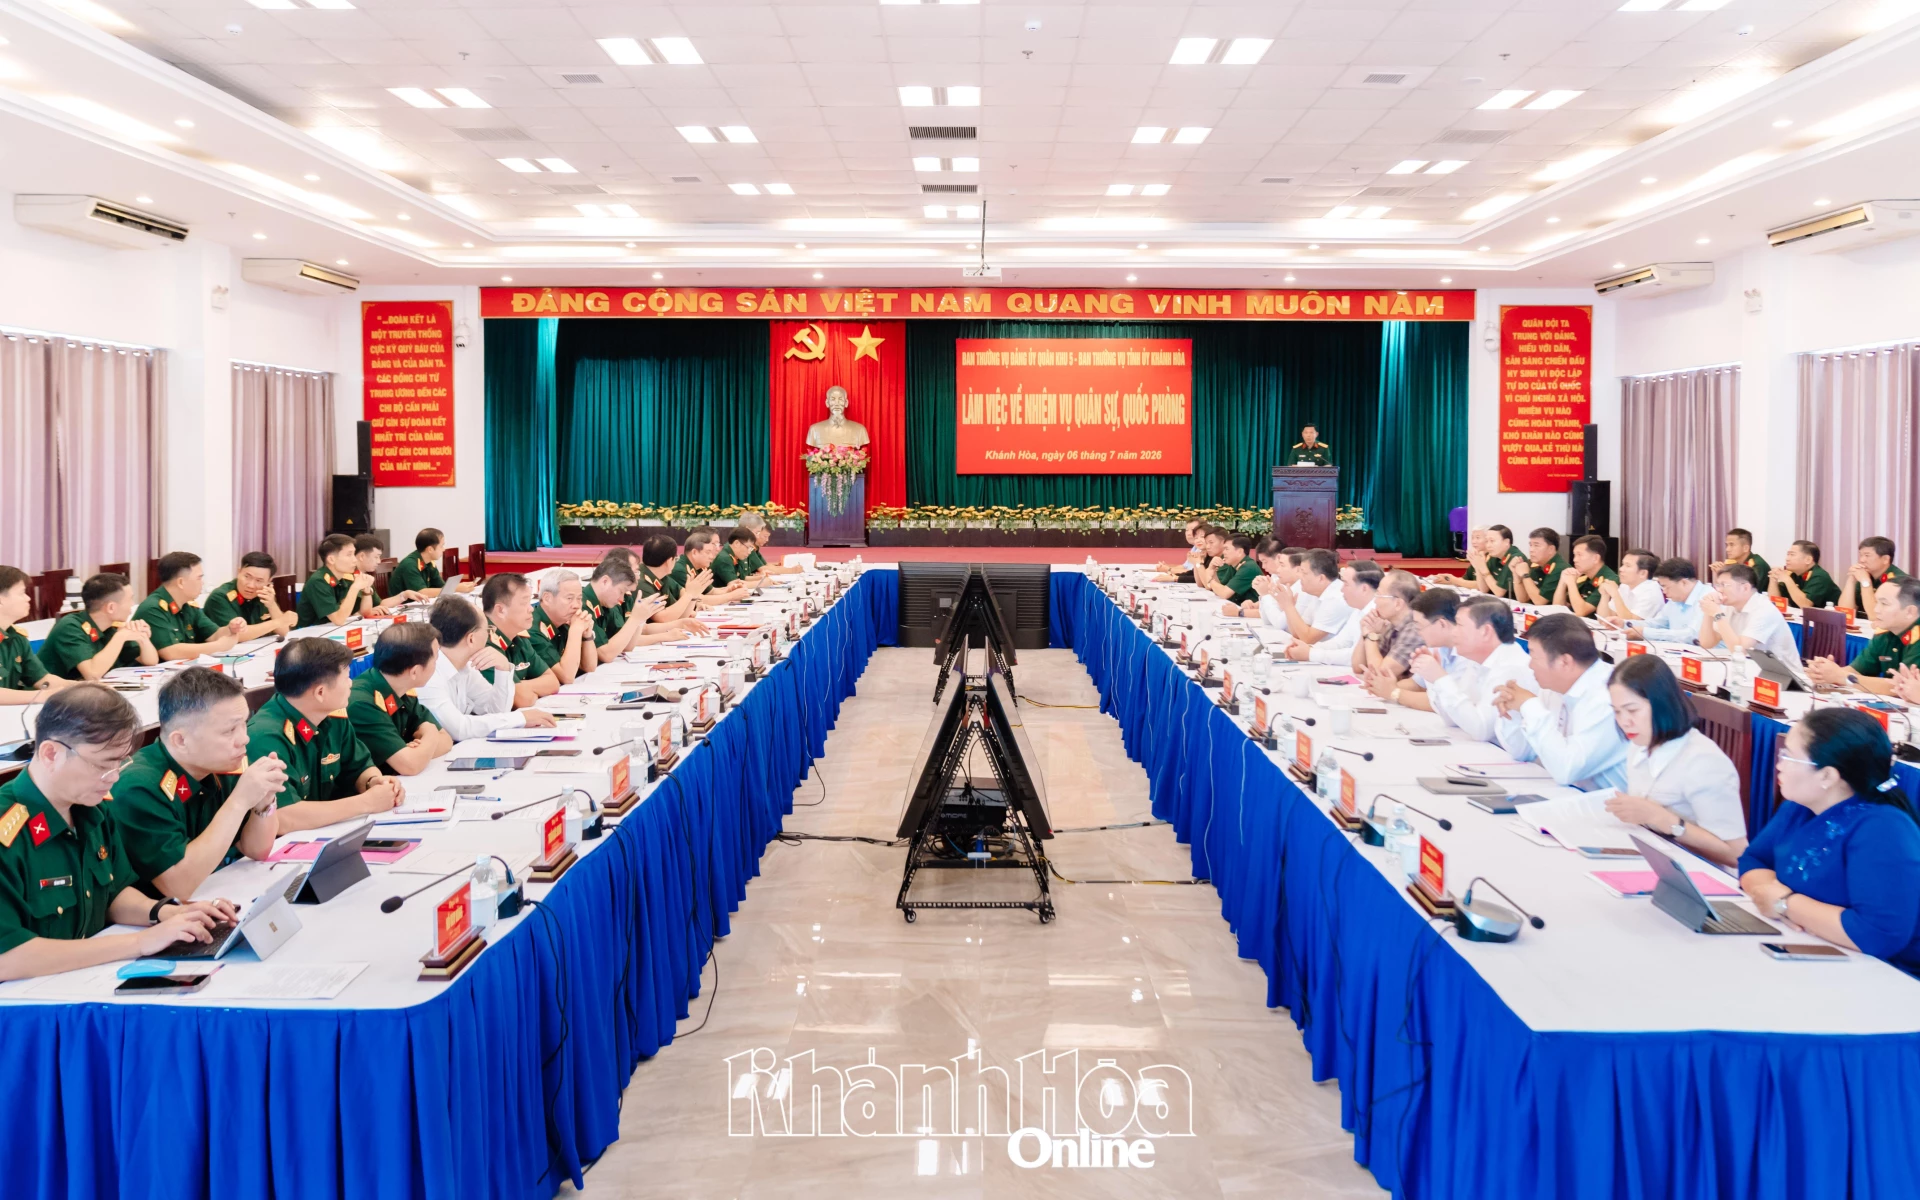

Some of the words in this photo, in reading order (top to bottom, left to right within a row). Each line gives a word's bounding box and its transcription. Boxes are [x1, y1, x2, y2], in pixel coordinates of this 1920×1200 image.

[511, 288, 610, 312] ĐẢNG
[622, 288, 724, 316] CỘNG
[736, 288, 807, 313] SẢN
[820, 288, 898, 316] VIỆT
[911, 293, 992, 312] NAM
[1006, 293, 1134, 314] QUANG
[1148, 294, 1232, 314] VINH
[1246, 290, 1350, 315] MUÔN
[1364, 291, 1444, 316] NĂM
[962, 352, 975, 365] BAN
[976, 349, 1000, 365] THƯỜNG
[1002, 352, 1009, 368] VỤ
[1010, 348, 1027, 365] ĐẢNG
[1038, 349, 1054, 367] QUÂN
[1056, 352, 1068, 365] KHU
[1069, 352, 1073, 365] 5
[1079, 352, 1091, 365] BAN
[1092, 349, 1116, 365] THƯỜNG
[1118, 352, 1125, 368] VỤ
[1127, 348, 1140, 365] TỈNH
[1151, 349, 1171, 365] KHÁNH
[1173, 349, 1185, 365] HÒA
[962, 387, 983, 424] LÀM
[986, 387, 1007, 431] VIỆC
[1025, 387, 1056, 431] NHIỆM
[1060, 394, 1072, 431] VỤ
[1075, 387, 1101, 428] QUÂN
[1104, 391, 1120, 431] SỰ,
[1123, 382, 1149, 428] QUỐC
[1152, 386, 1185, 424] PHÒNG
[985, 450, 1015, 460] Khánh
[1018, 450, 1039, 461] Hòa,
[1042, 451, 1064, 461] ngày
[1067, 451, 1078, 460] 06
[1080, 450, 1107, 461] tháng
[1110, 451, 1115, 460] 7
[1118, 451, 1137, 460] năm
[1140, 451, 1161, 460] 2026
[1572, 443, 1584, 452] NÀ
